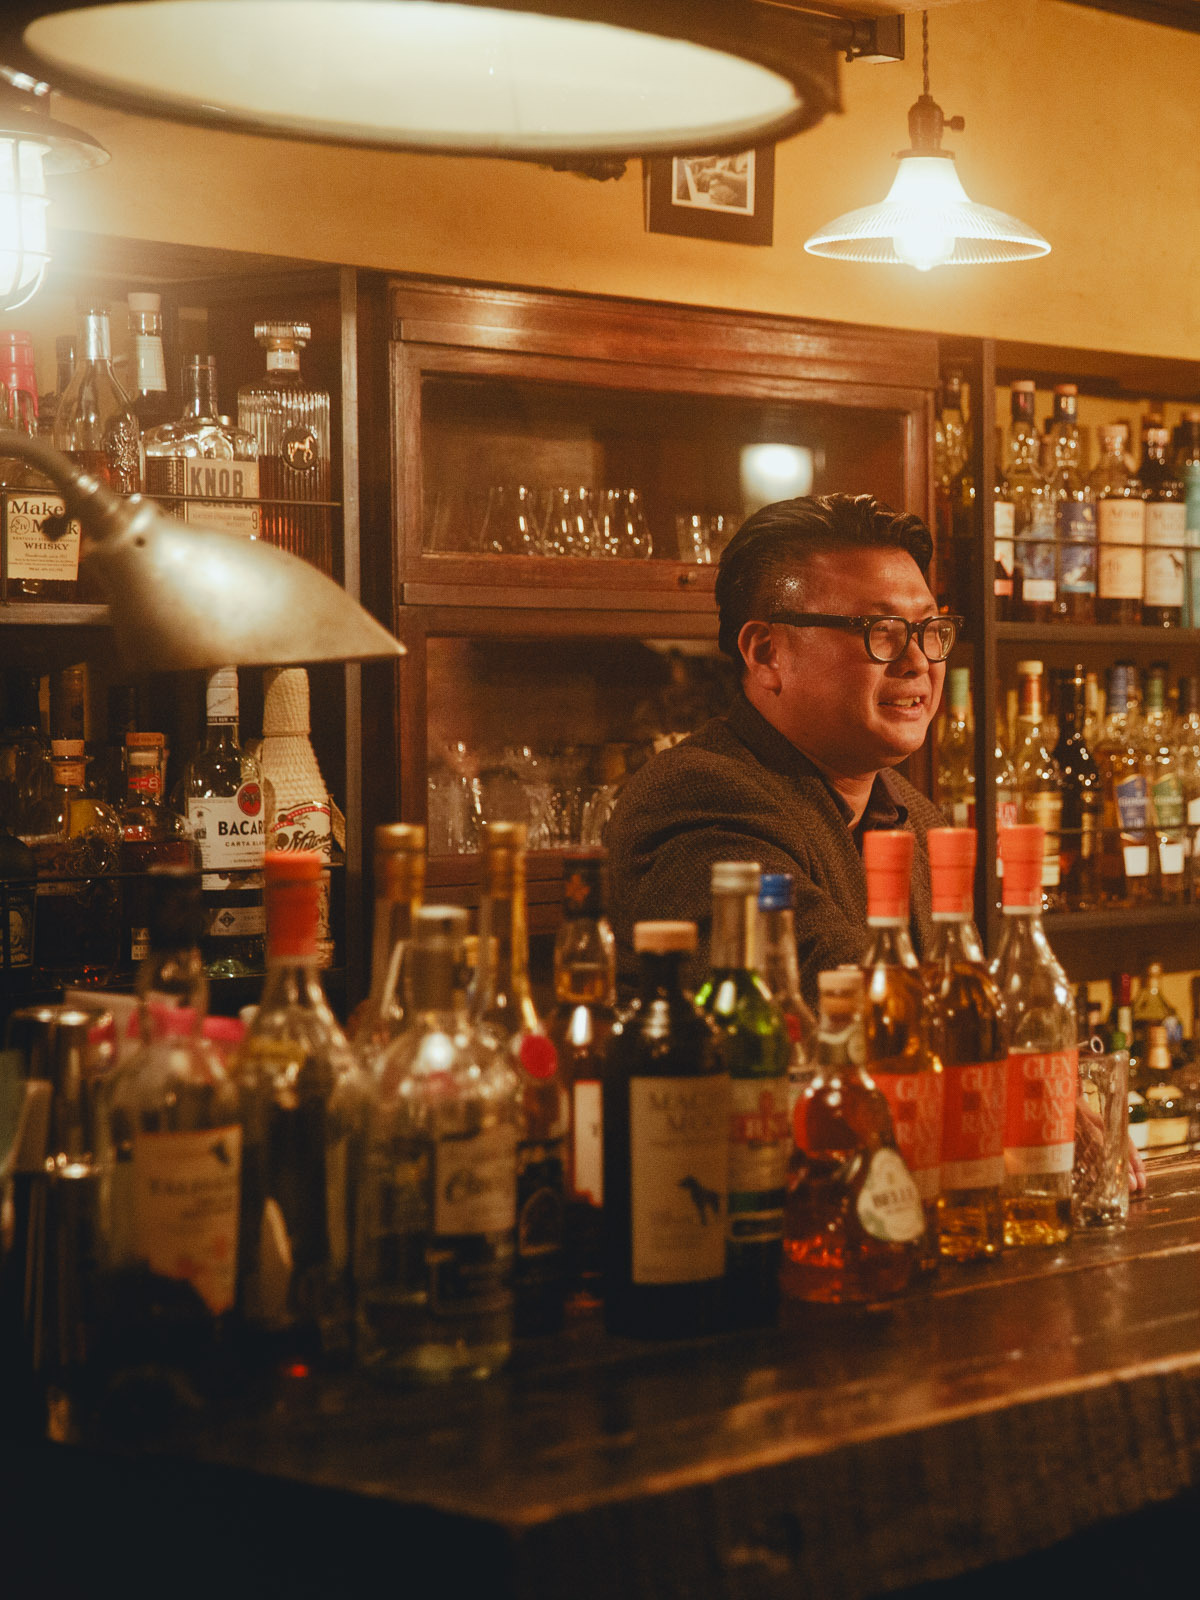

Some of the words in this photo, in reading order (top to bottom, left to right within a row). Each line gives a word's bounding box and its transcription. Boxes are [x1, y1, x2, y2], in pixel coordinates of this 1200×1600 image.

[190, 467, 243, 497] KNOB
[32, 519, 78, 534] Mk
[251, 511, 258, 530] 9
[24, 542, 69, 550] WHISKY
[1023, 1056, 1072, 1080] GLEN
